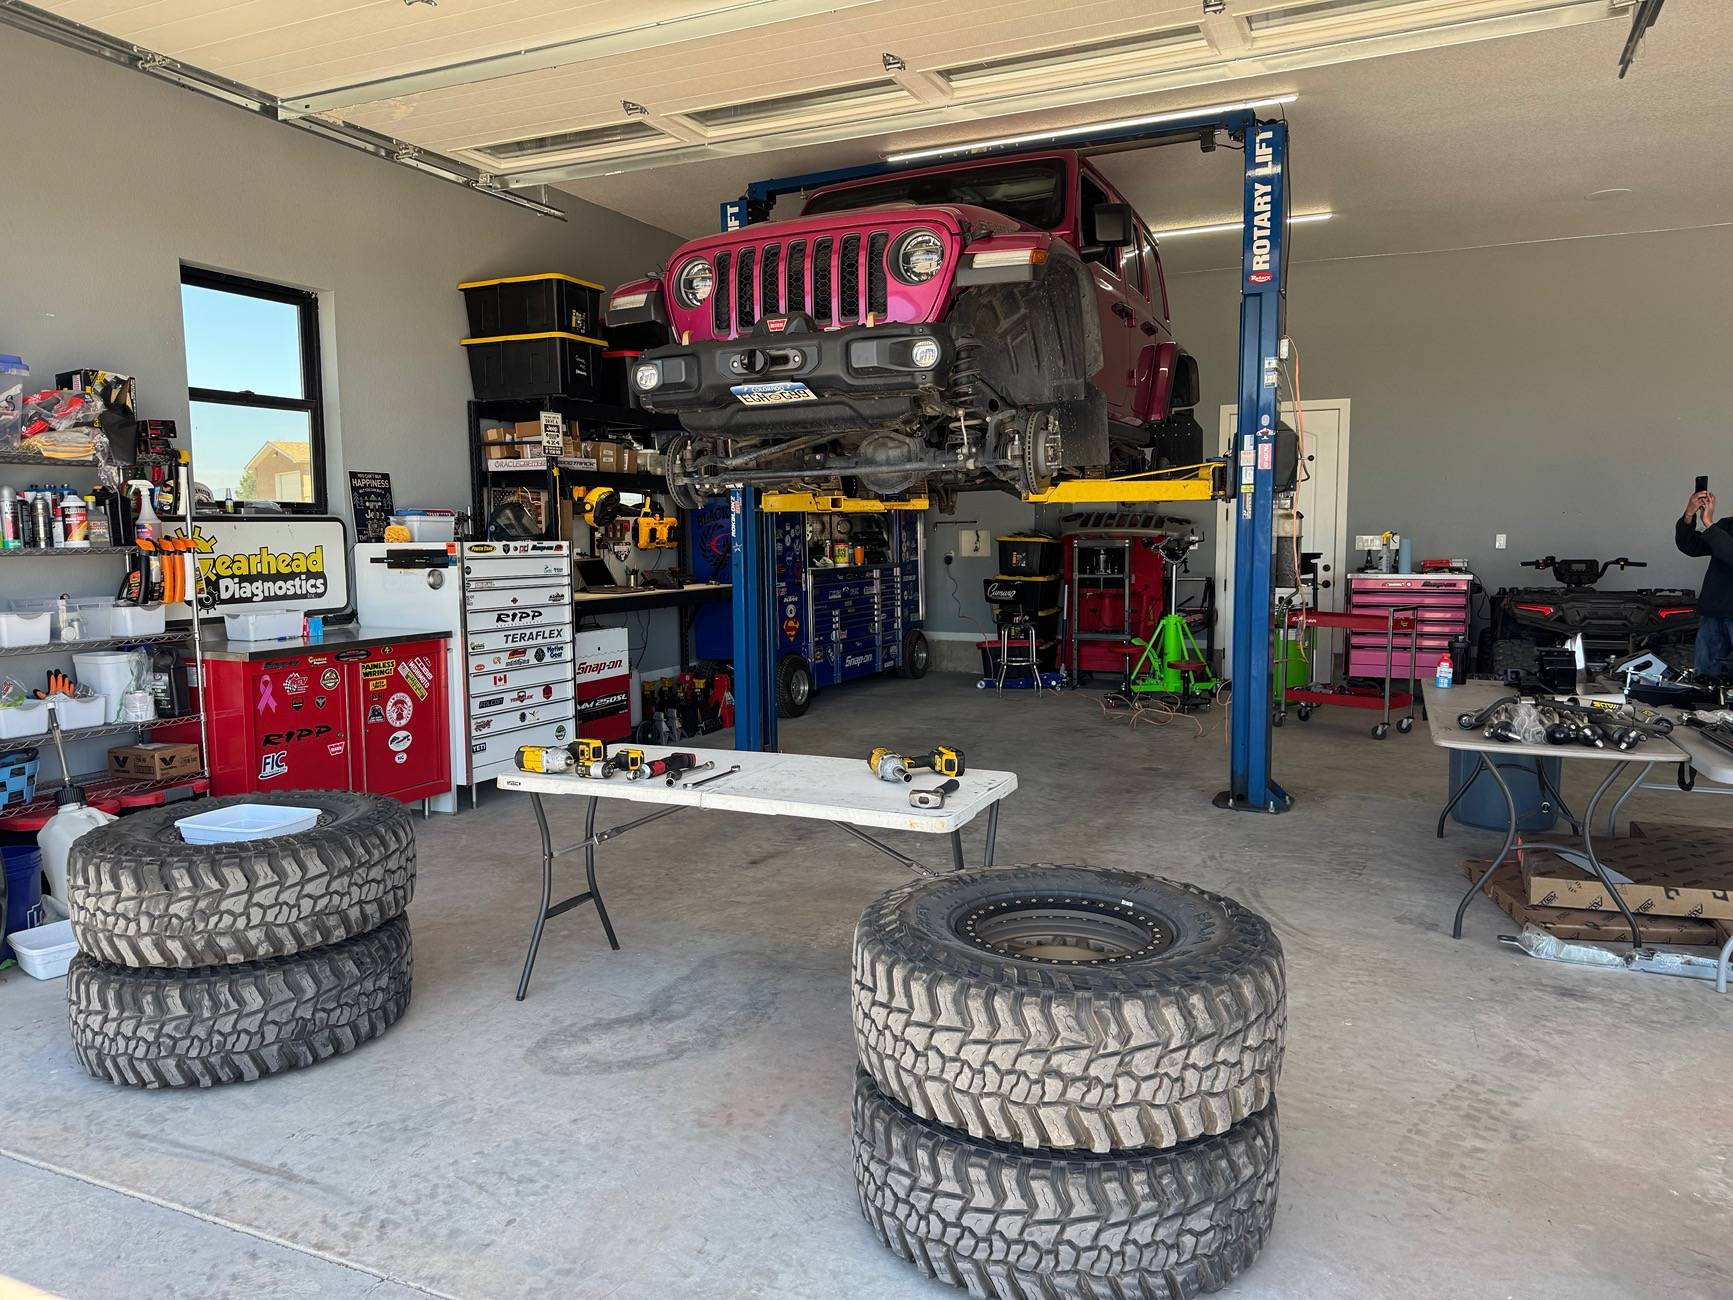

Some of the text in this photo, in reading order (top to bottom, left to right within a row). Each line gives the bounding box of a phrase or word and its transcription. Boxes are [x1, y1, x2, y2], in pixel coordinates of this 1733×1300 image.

[1253, 130, 1274, 270] ROTARY LIFT
[727, 205, 740, 231] IFT
[751, 385, 785, 393] COLORADO
[351, 478, 390, 488] HAPPINESS
[219, 574, 326, 602] Diagnostics
[987, 582, 1017, 600] Camaro
[495, 610, 543, 624] RIPP
[503, 628, 563, 644] TERAFLEX
[361, 660, 395, 671] PAINLESS
[576, 659, 623, 676] Snap-on
[845, 653, 873, 668] Snap-on
[361, 668, 393, 678] WIRING!
[261, 725, 333, 747] RIPP
[473, 743, 486, 752] YETI
[261, 751, 287, 773] FIC
